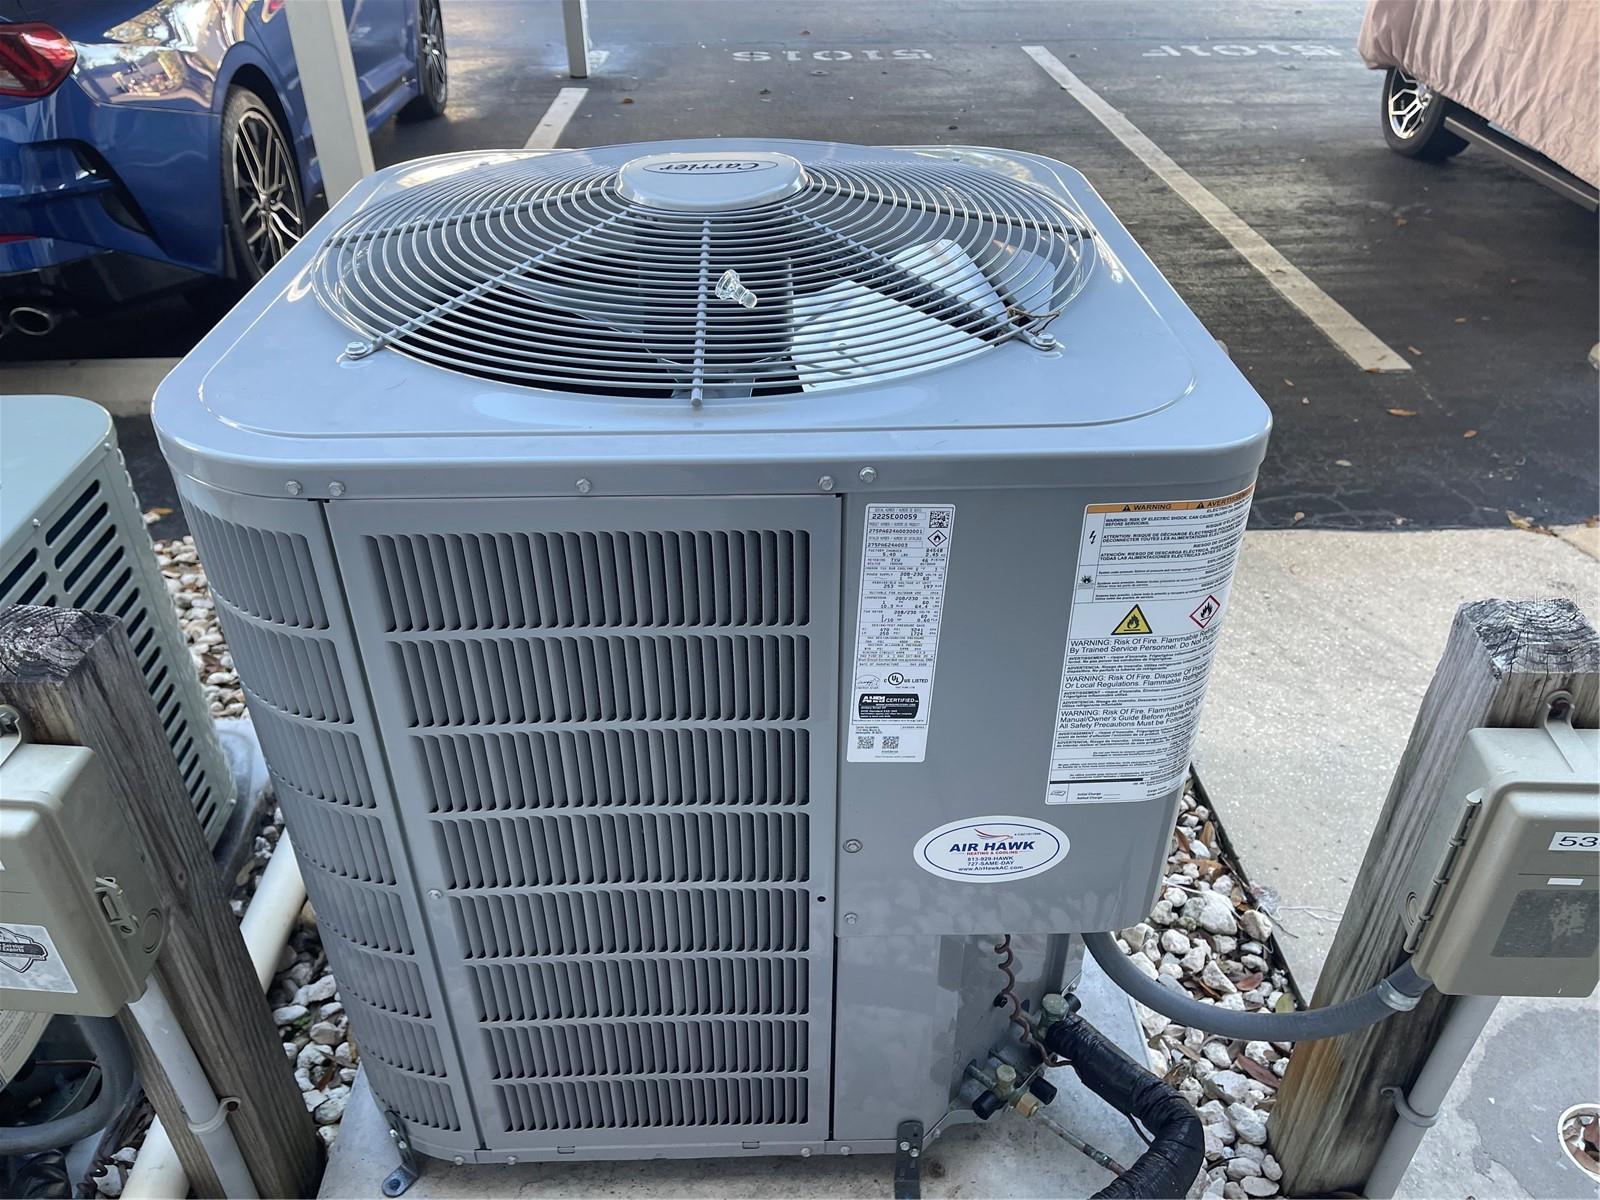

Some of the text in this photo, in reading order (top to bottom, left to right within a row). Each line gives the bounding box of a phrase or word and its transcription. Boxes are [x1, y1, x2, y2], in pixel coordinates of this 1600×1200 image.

[660, 162, 759, 171] Carrier
[1161, 633, 1199, 644] Flammable
[1191, 638, 1201, 646] Not
[1154, 671, 1182, 681] Dispose
[1183, 668, 1191, 676] Of
[1143, 678, 1181, 686] Flammable
[1148, 704, 1184, 713] Flammable
[949, 841, 1035, 852] AIR HAWK
